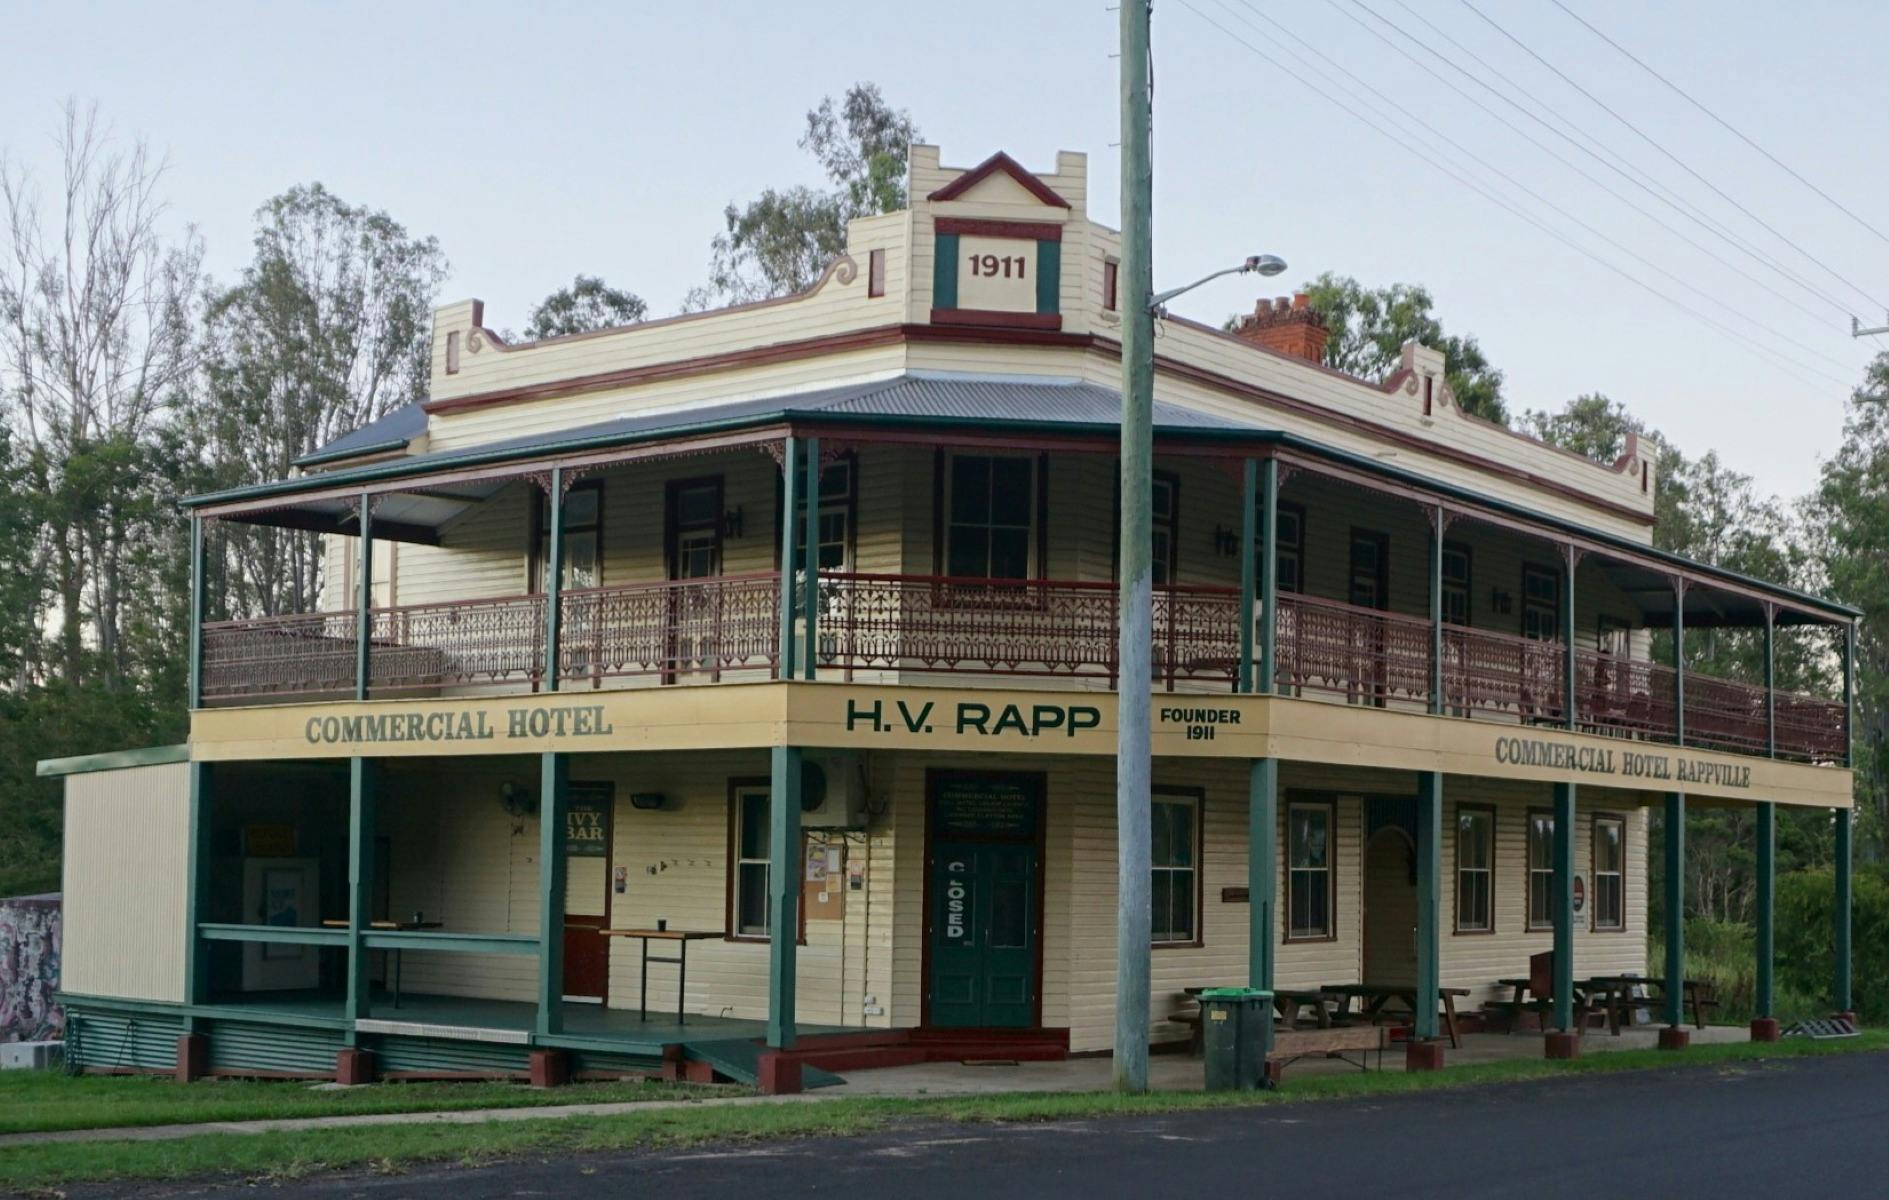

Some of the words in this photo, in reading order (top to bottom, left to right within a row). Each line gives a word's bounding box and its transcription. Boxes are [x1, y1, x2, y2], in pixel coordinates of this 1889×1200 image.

[968, 254, 1026, 279] 1911
[305, 711, 494, 744] COMMERCIAL
[507, 705, 614, 738] HOTEL
[846, 699, 933, 733] H.V.
[956, 703, 1101, 737] RAPP
[1160, 708, 1241, 724] FOUNDER
[1186, 725, 1215, 740] 1911
[1495, 736, 1615, 774] COMMERCIAL
[1622, 752, 1671, 779] HOTEL
[1677, 758, 1751, 788] RAPPVILLE
[566, 812, 602, 826] IVY
[947, 861, 965, 938] CLOSED
